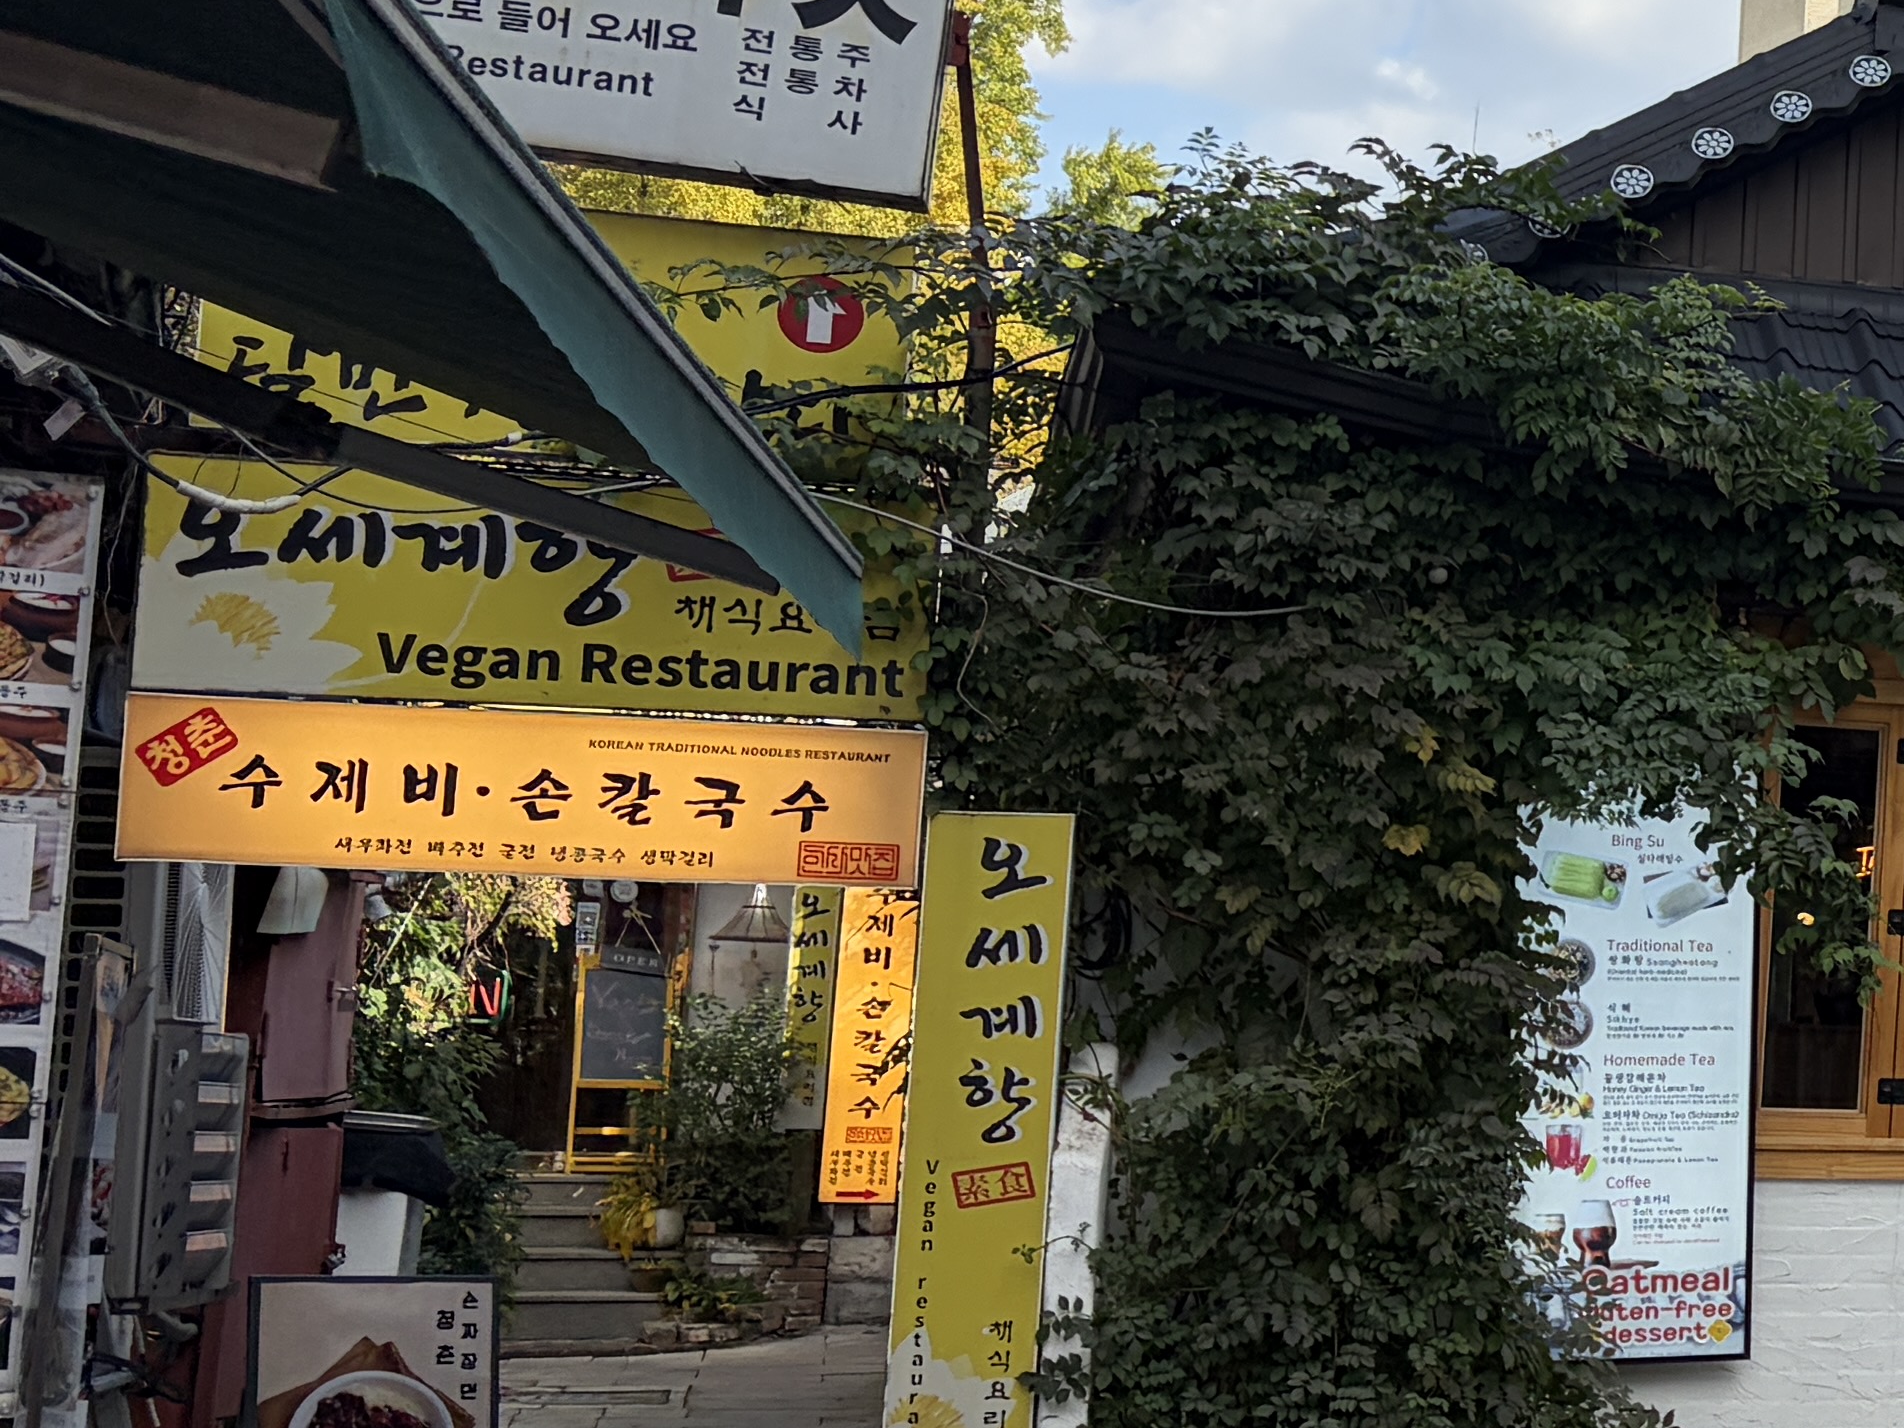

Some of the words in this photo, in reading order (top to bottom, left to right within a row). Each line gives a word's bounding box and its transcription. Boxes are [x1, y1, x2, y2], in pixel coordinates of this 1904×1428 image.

[497, 0, 571, 39] 들어
[585, 13, 698, 53] 오세요
[377, 632, 561, 690] Vegan
[581, 643, 905, 698] Restaurant
[145, 713, 233, 776] 청춘
[588, 739, 644, 751] KOREAN
[648, 742, 738, 756] TRADITIONAL
[740, 746, 801, 760] NOODLES
[804, 749, 892, 763] RESTAURANT
[1612, 834, 1643, 851] Bing
[1647, 835, 1665, 848] Su
[1606, 939, 1684, 952] Traditional
[1688, 939, 1713, 952] Tea
[959, 836, 1050, 1145] 오세계향
[1603, 1053, 1686, 1067] Homemade
[1689, 1053, 1716, 1067] Tea
[1605, 1175, 1652, 1189] Coffee
[921, 1159, 939, 1252] Vegan
[1657, 1208, 1690, 1216] cream
[1692, 1207, 1729, 1215] coffee
[1583, 1266, 1731, 1297] Oatmeal
[1603, 1322, 1708, 1344] dessert
